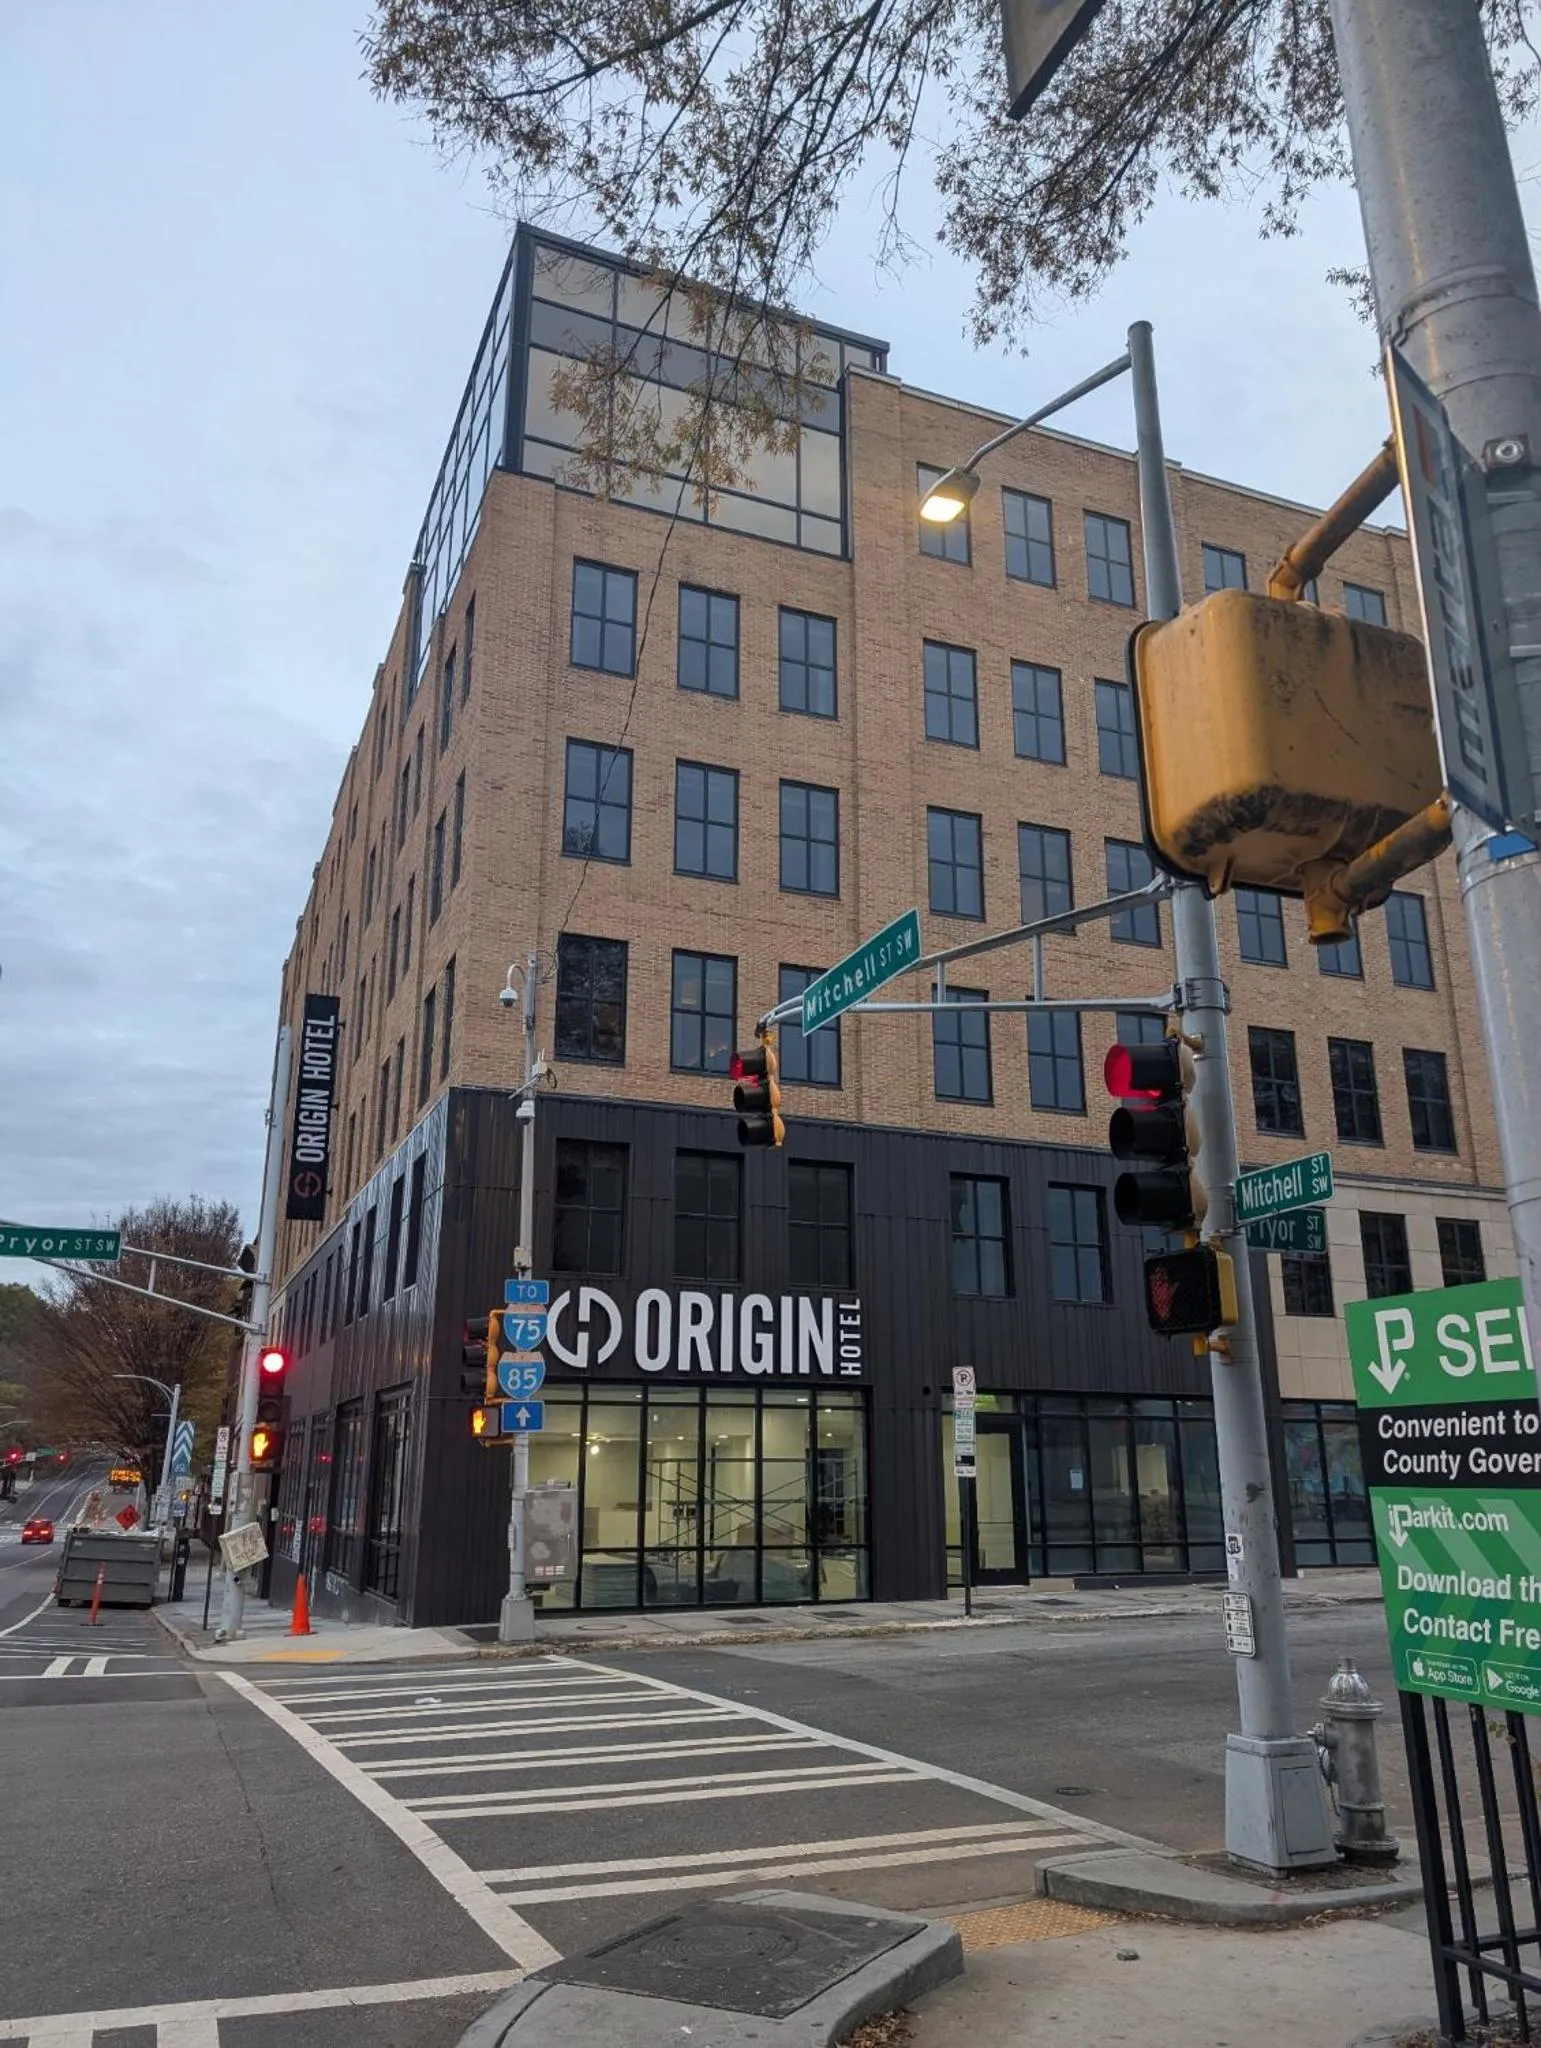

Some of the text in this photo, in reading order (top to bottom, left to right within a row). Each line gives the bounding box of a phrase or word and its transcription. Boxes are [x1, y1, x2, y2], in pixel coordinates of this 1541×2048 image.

[806, 928, 912, 1021] Mitchell ST SW
[295, 1015, 335, 1163] ORIGIN HOTEL
[1241, 1156, 1328, 1211] Mitchell ST SW
[1307, 1216, 1320, 1231] ST
[74, 1239, 91, 1251] ST
[96, 1239, 115, 1252] SW
[1307, 1234, 1322, 1250] SW
[517, 1285, 537, 1298] TO
[512, 1319, 540, 1341] 75
[635, 1288, 833, 1375] ORIGIN
[839, 1298, 861, 1376] HOTEL
[507, 1368, 537, 1390] 85
[1378, 1409, 1540, 1438] Convenient to
[1383, 1449, 1461, 1480] County
[1397, 1565, 1511, 1600] Download
[1403, 1608, 1541, 1650] Contact Fre
[1428, 1667, 1473, 1686] App Store
[1506, 1680, 1541, 1699] Google
